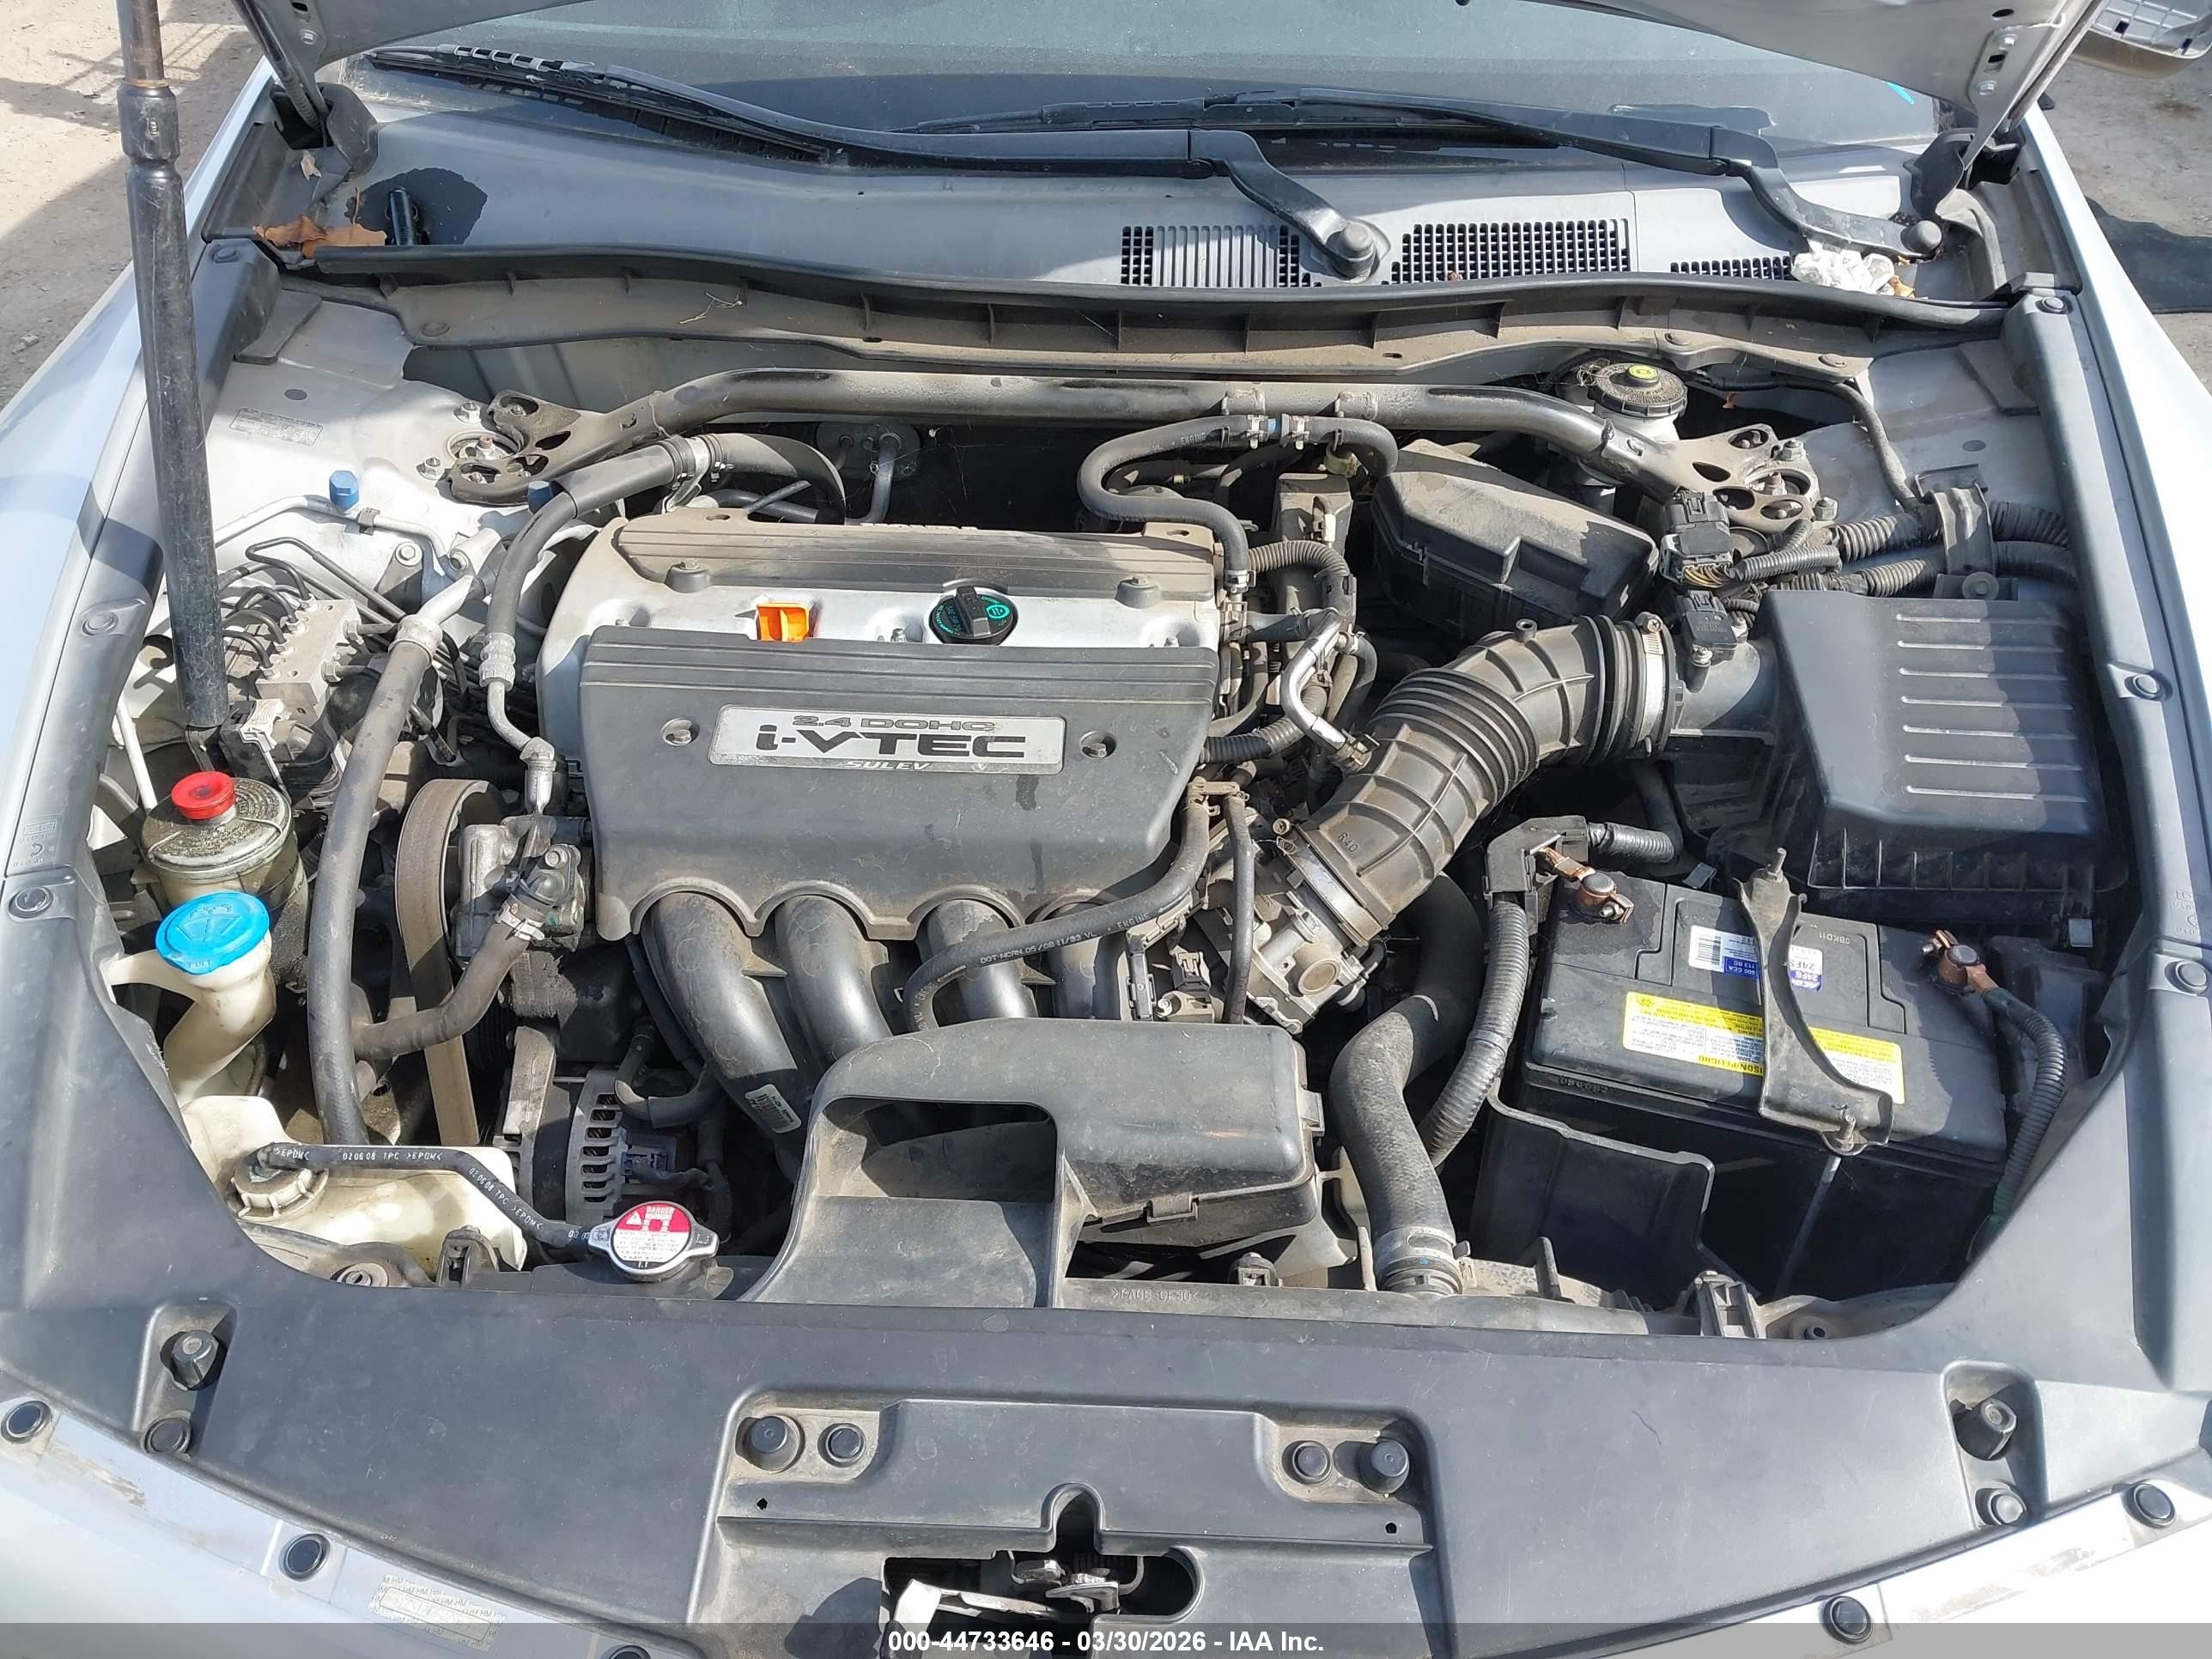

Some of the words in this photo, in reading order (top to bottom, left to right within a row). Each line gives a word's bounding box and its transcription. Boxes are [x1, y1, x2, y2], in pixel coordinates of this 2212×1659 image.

[793, 715, 851, 729] 2.4
[860, 718, 997, 731] DOHC
[755, 724, 1026, 758] i-VTEC
[846, 760, 932, 771] SULEV
[1116, 911, 1152, 929] ENGINE
[1728, 965, 1743, 973] CCA
[646, 1205, 676, 1214] DANGER
